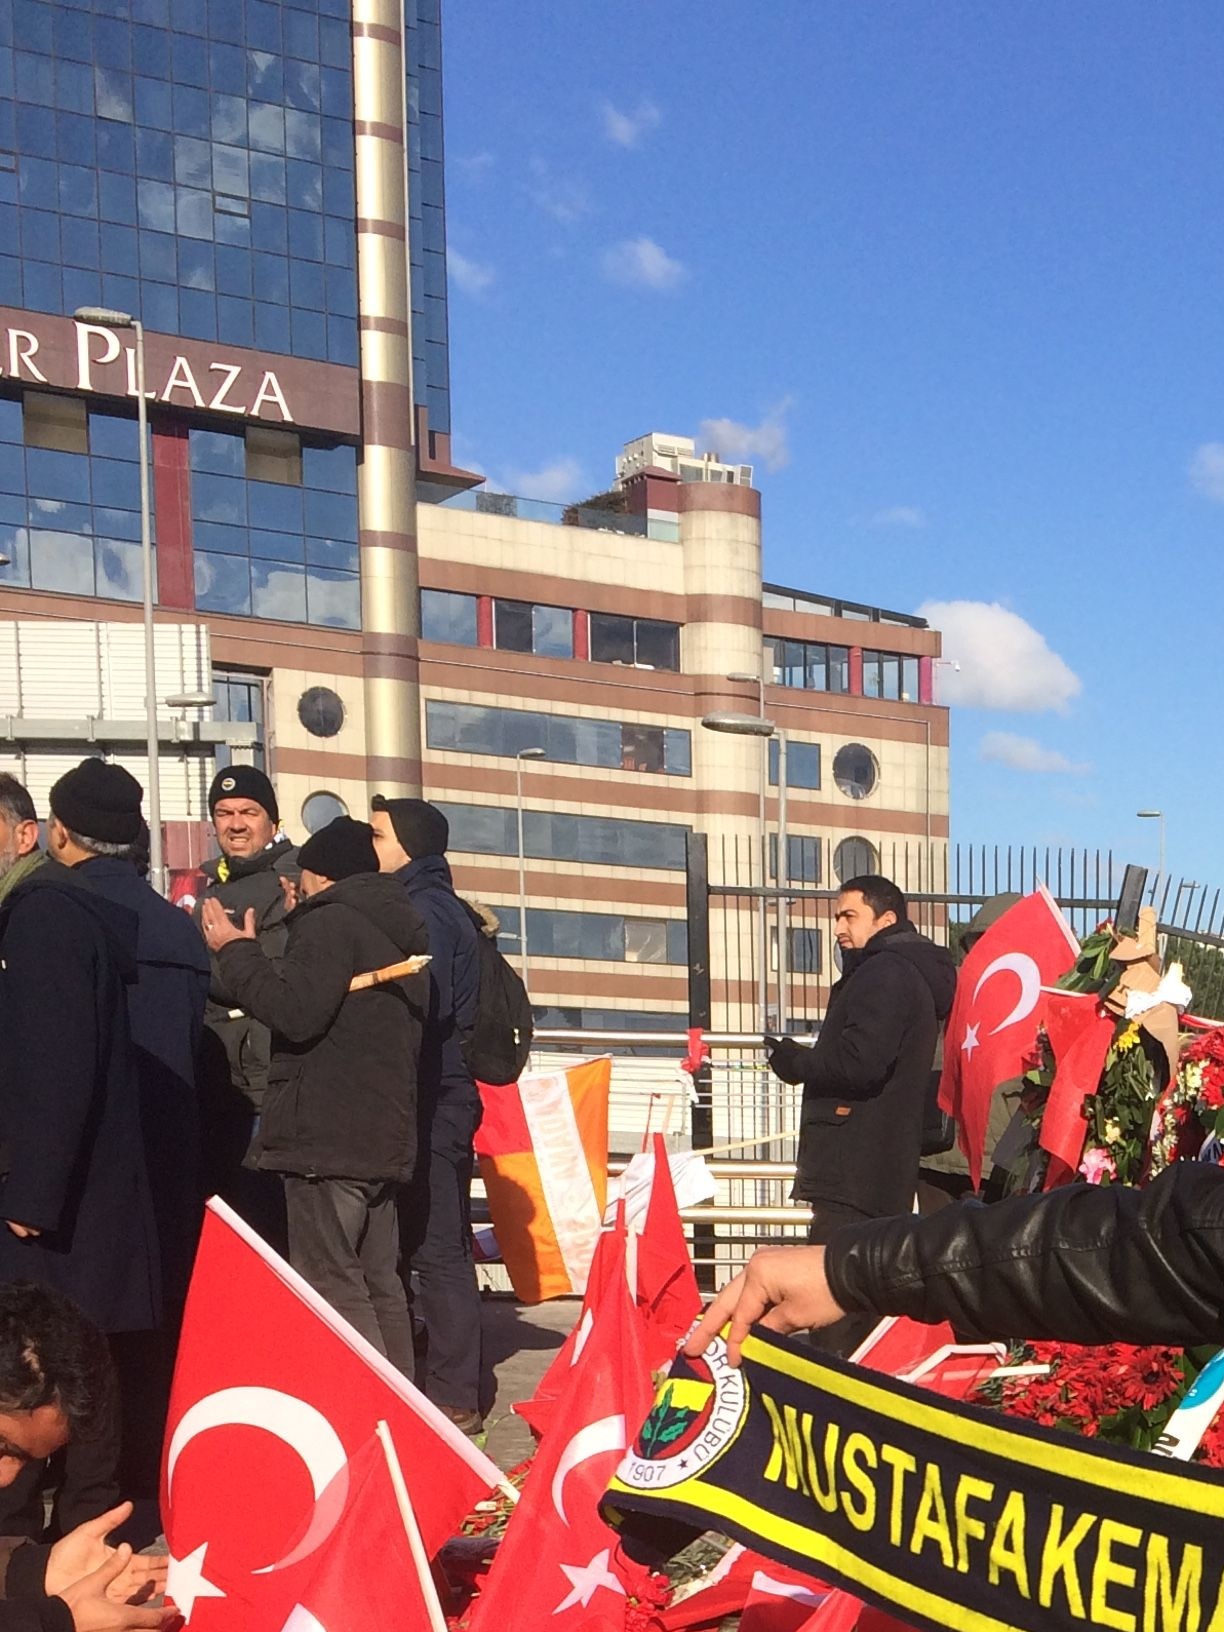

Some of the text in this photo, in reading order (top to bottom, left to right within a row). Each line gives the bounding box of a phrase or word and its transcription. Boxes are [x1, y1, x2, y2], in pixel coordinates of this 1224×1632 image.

[0, 321, 294, 423] R PLAZA
[693, 1374, 739, 1462] KULÜBÜ
[630, 1461, 666, 1482] 1907
